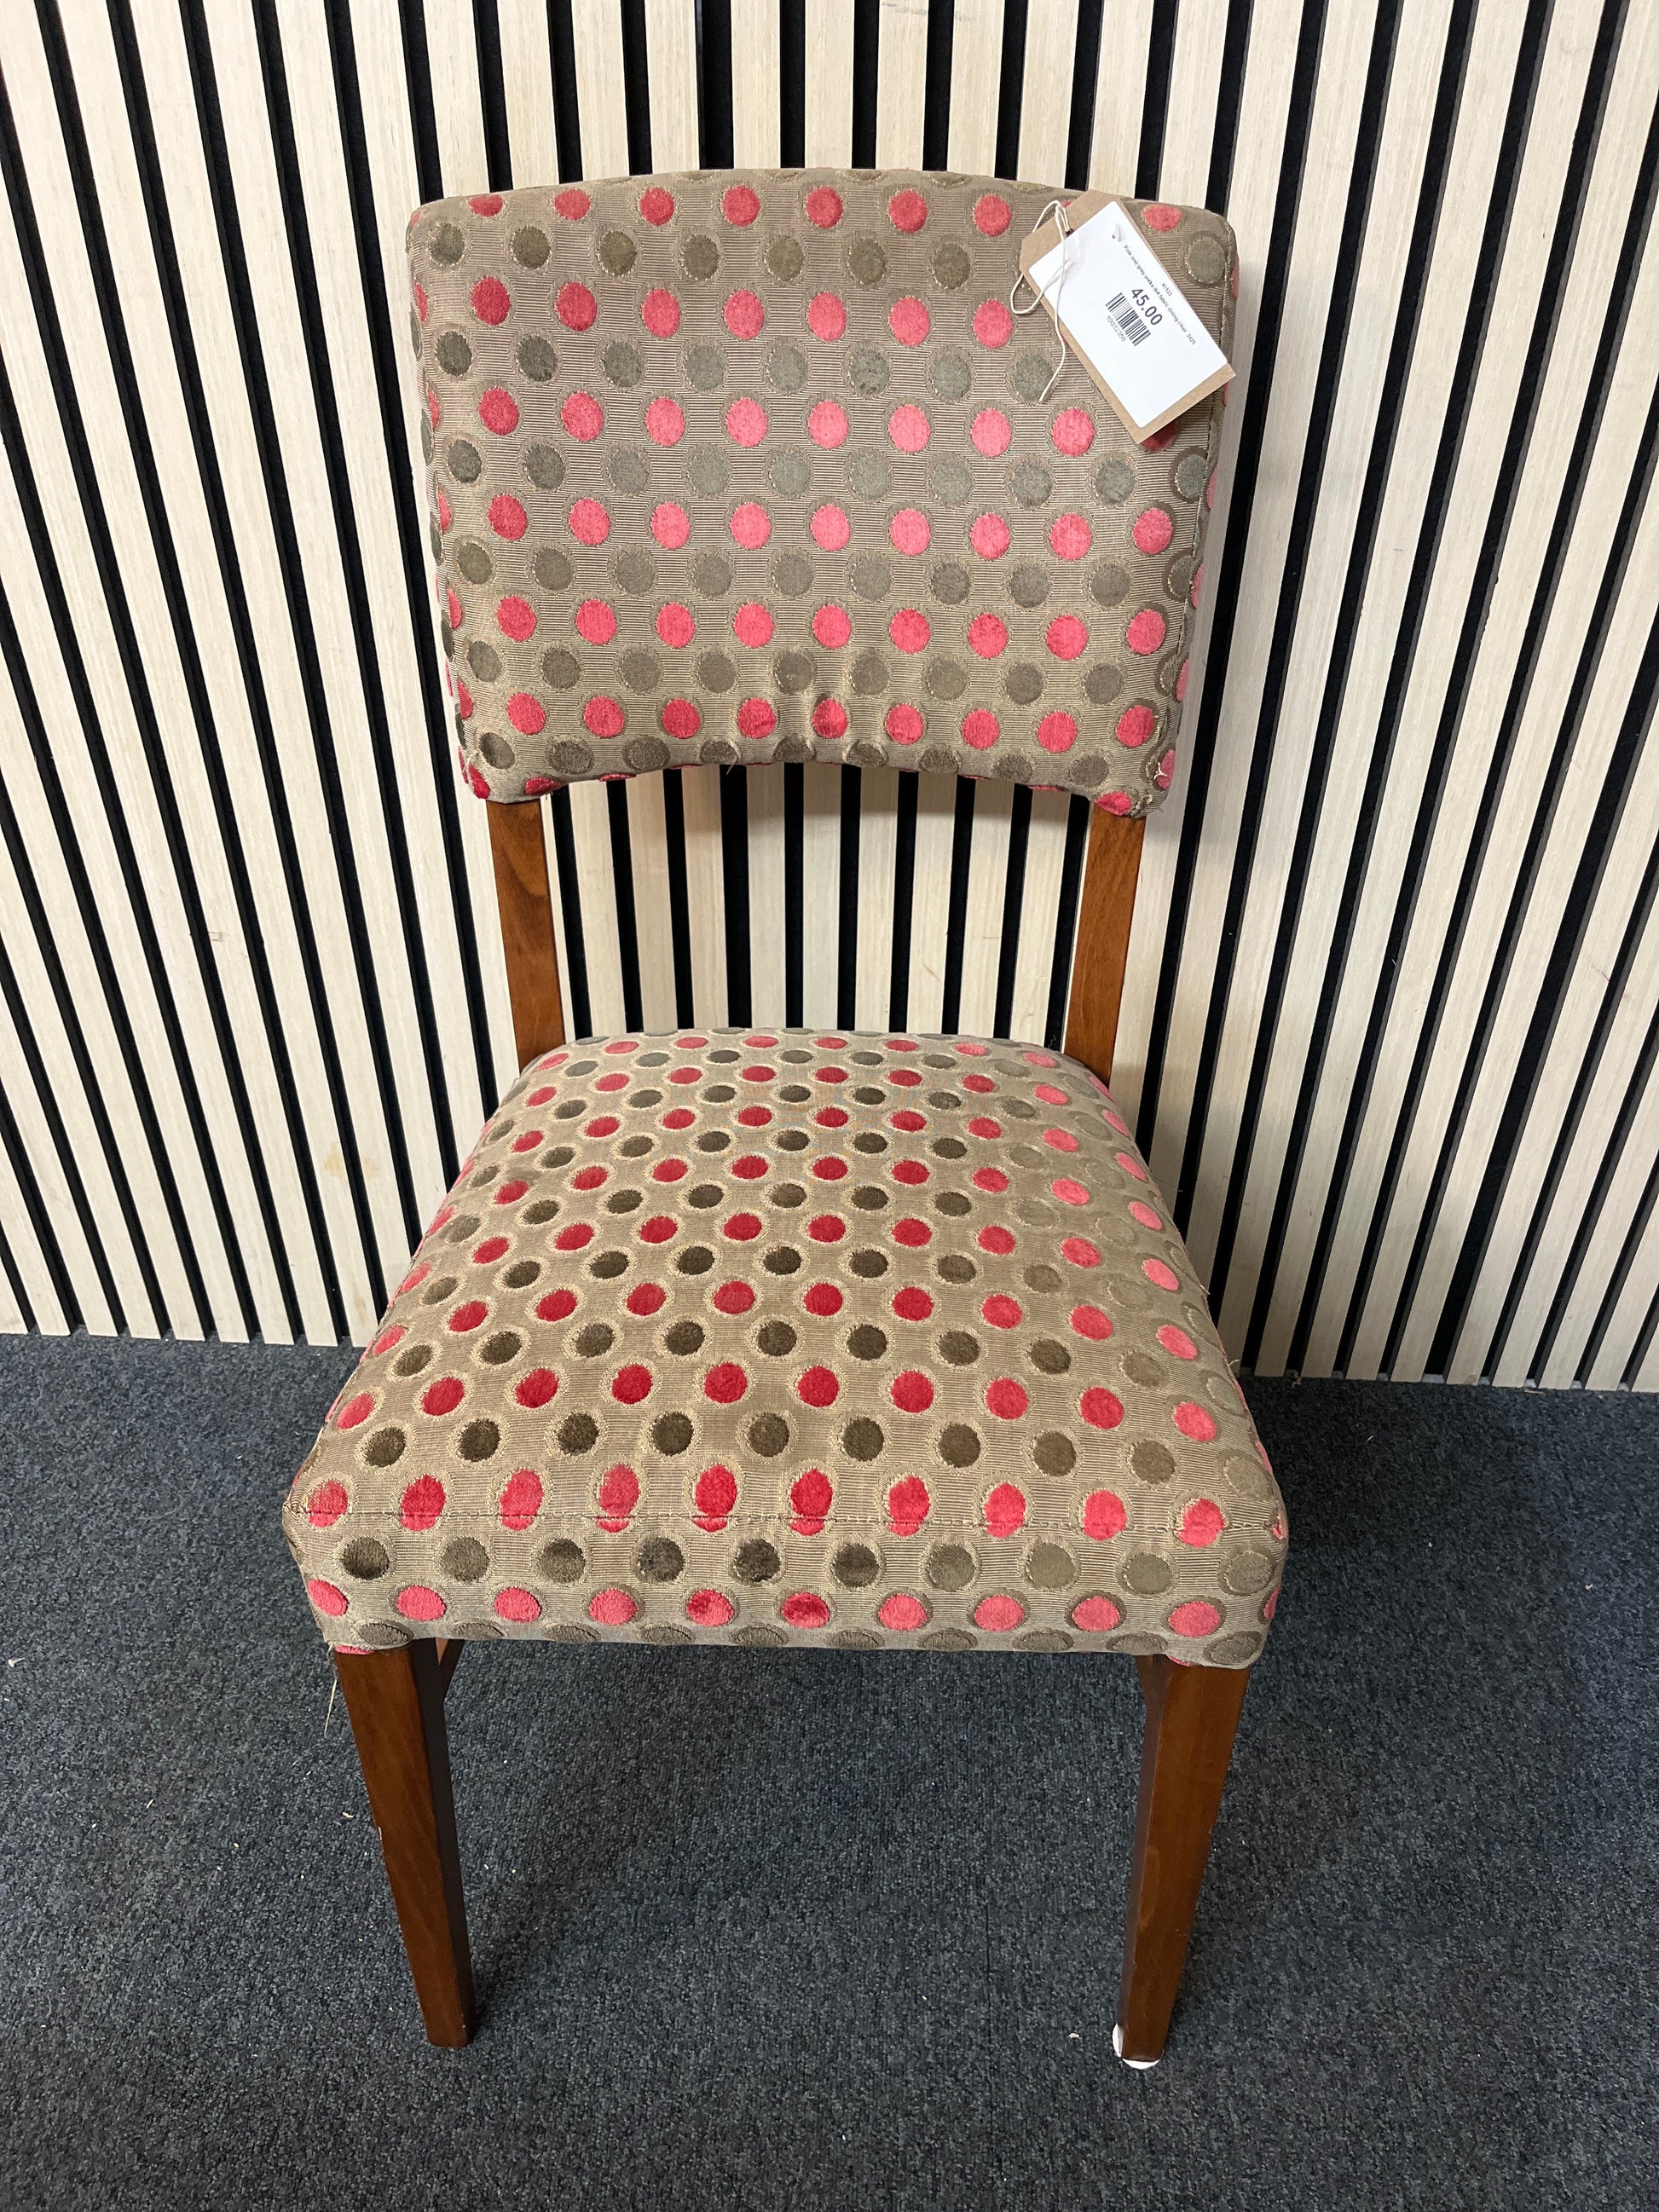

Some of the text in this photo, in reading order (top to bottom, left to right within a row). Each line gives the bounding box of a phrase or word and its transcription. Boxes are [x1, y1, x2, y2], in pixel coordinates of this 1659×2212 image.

[1130, 288, 1163, 326] 45.00
[1144, 274, 1154, 287] polka
[1159, 294, 1169, 307] fabric
[1167, 307, 1179, 322] dining
[1177, 321, 1187, 332] chair
